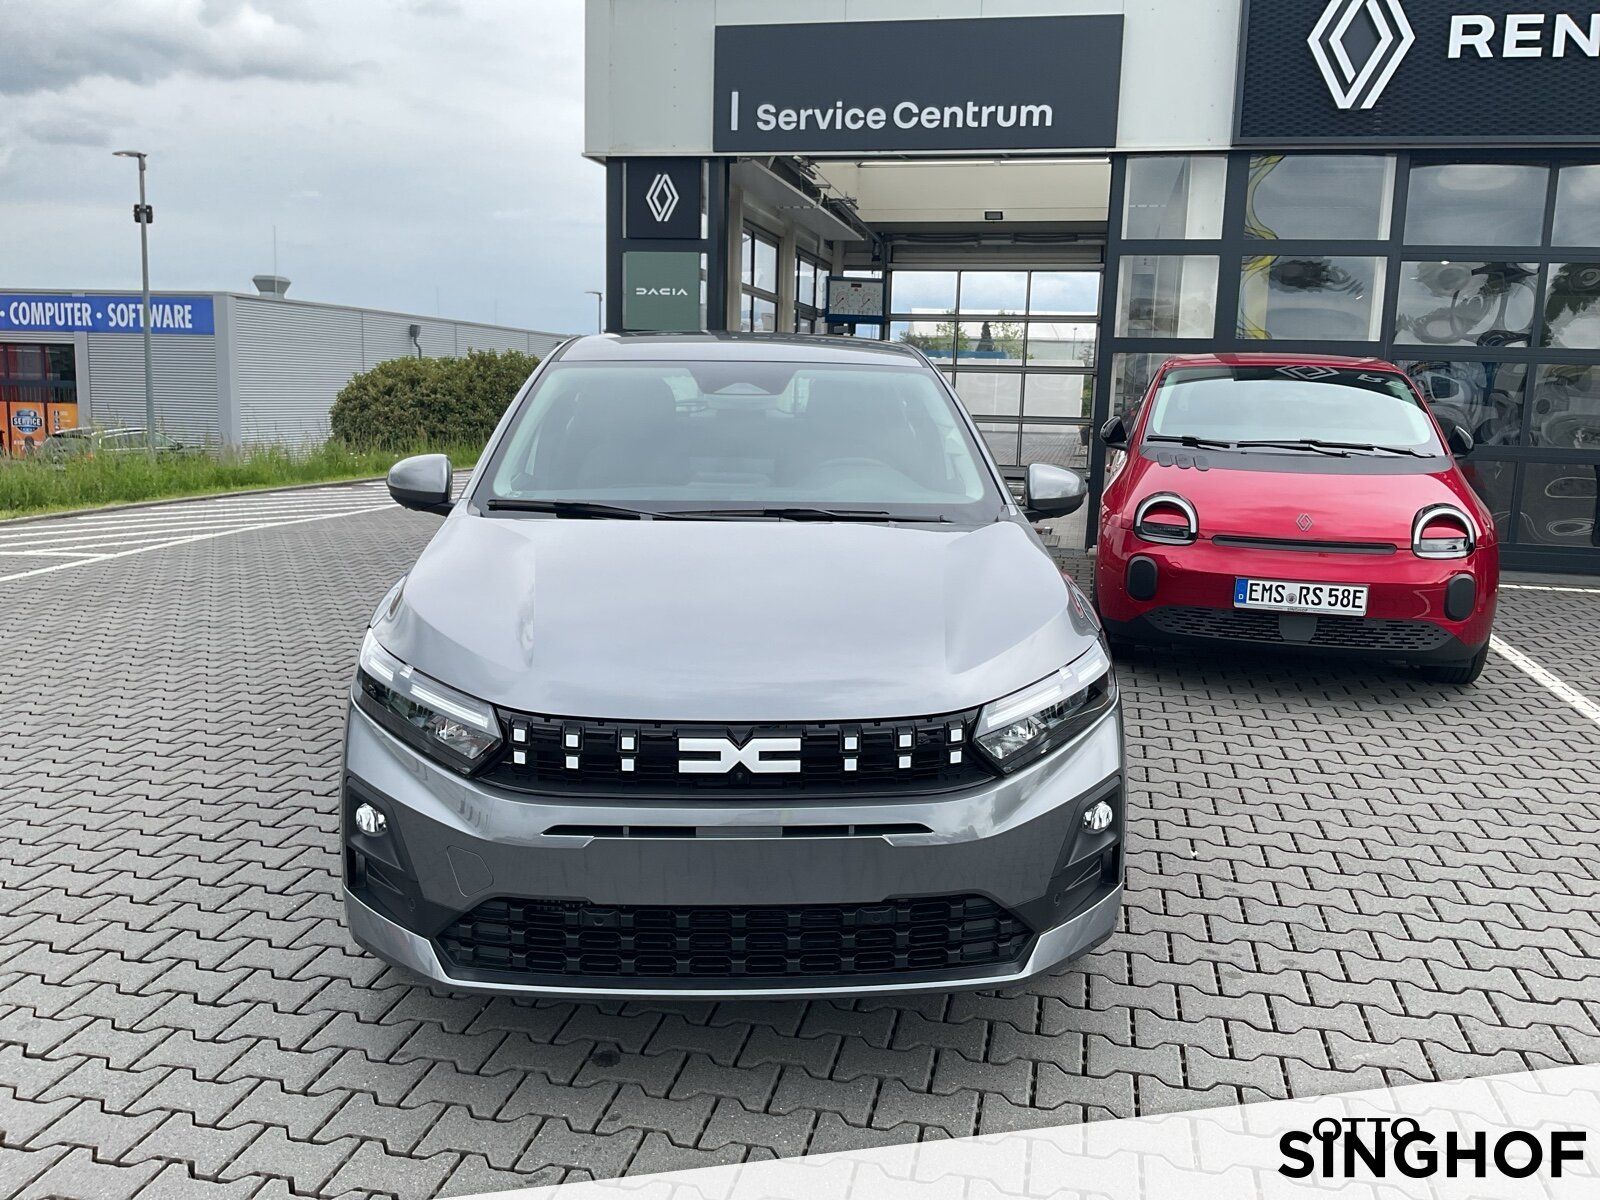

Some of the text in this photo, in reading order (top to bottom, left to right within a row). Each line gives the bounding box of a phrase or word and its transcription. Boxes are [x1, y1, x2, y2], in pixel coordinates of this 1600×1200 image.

[1448, 13, 1600, 58] REN
[756, 100, 1053, 131] Service Centrum
[635, 287, 688, 296] DACIA
[9, 301, 193, 329] COMPUTER SOFTWARE
[1248, 582, 1364, 609] EMS RS 58E
